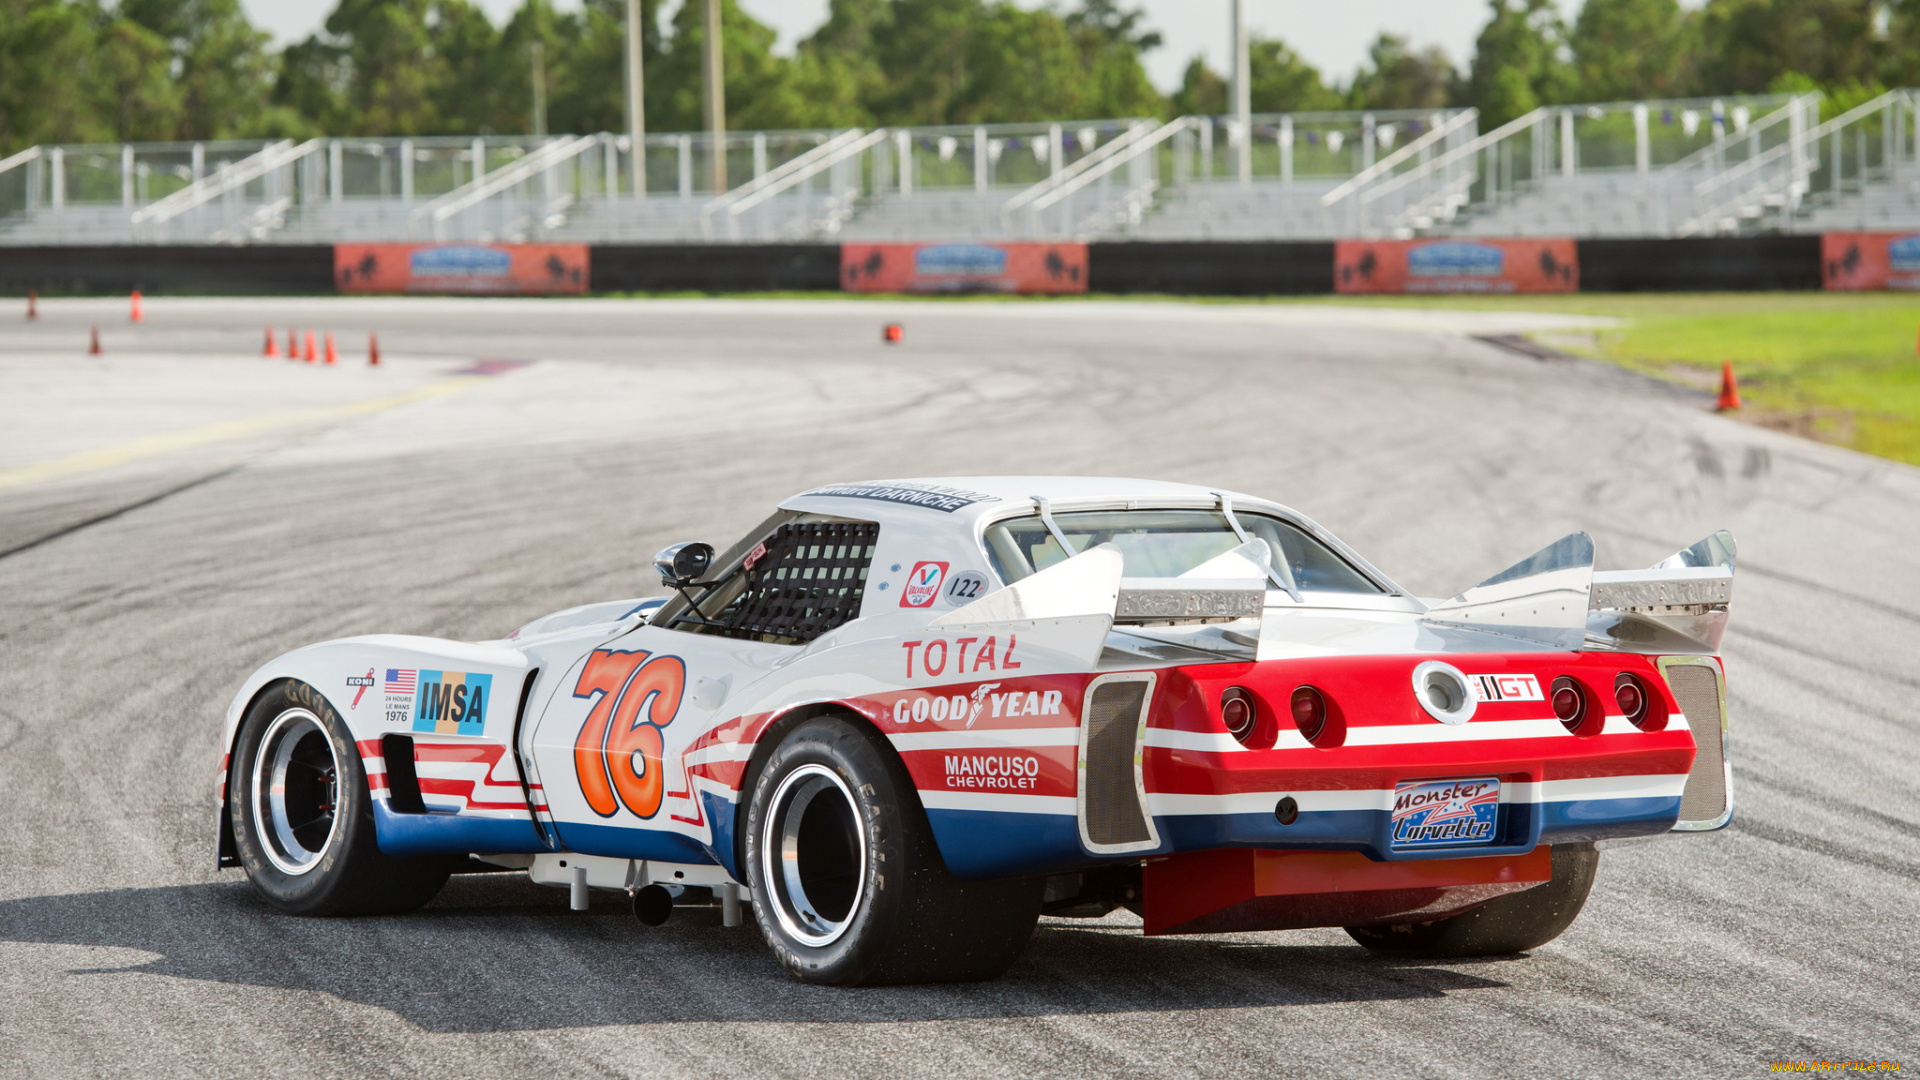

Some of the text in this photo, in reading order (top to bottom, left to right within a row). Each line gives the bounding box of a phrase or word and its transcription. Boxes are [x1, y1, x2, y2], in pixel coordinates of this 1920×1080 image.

[871, 487, 969, 511] DARNICHE
[949, 578, 981, 598] 122
[902, 634, 1022, 679] TOTAL
[348, 678, 373, 686] KONI
[1497, 677, 1535, 698] GT
[420, 682, 483, 723] IMSA
[385, 711, 408, 722] 1976
[572, 648, 687, 820] 76
[944, 755, 1039, 777] MANCUSO
[946, 776, 1037, 789] CHEVROLET
[1393, 782, 1489, 813] Monster
[858, 783, 886, 891] EAGLE
[1393, 816, 1491, 842] Corvette
